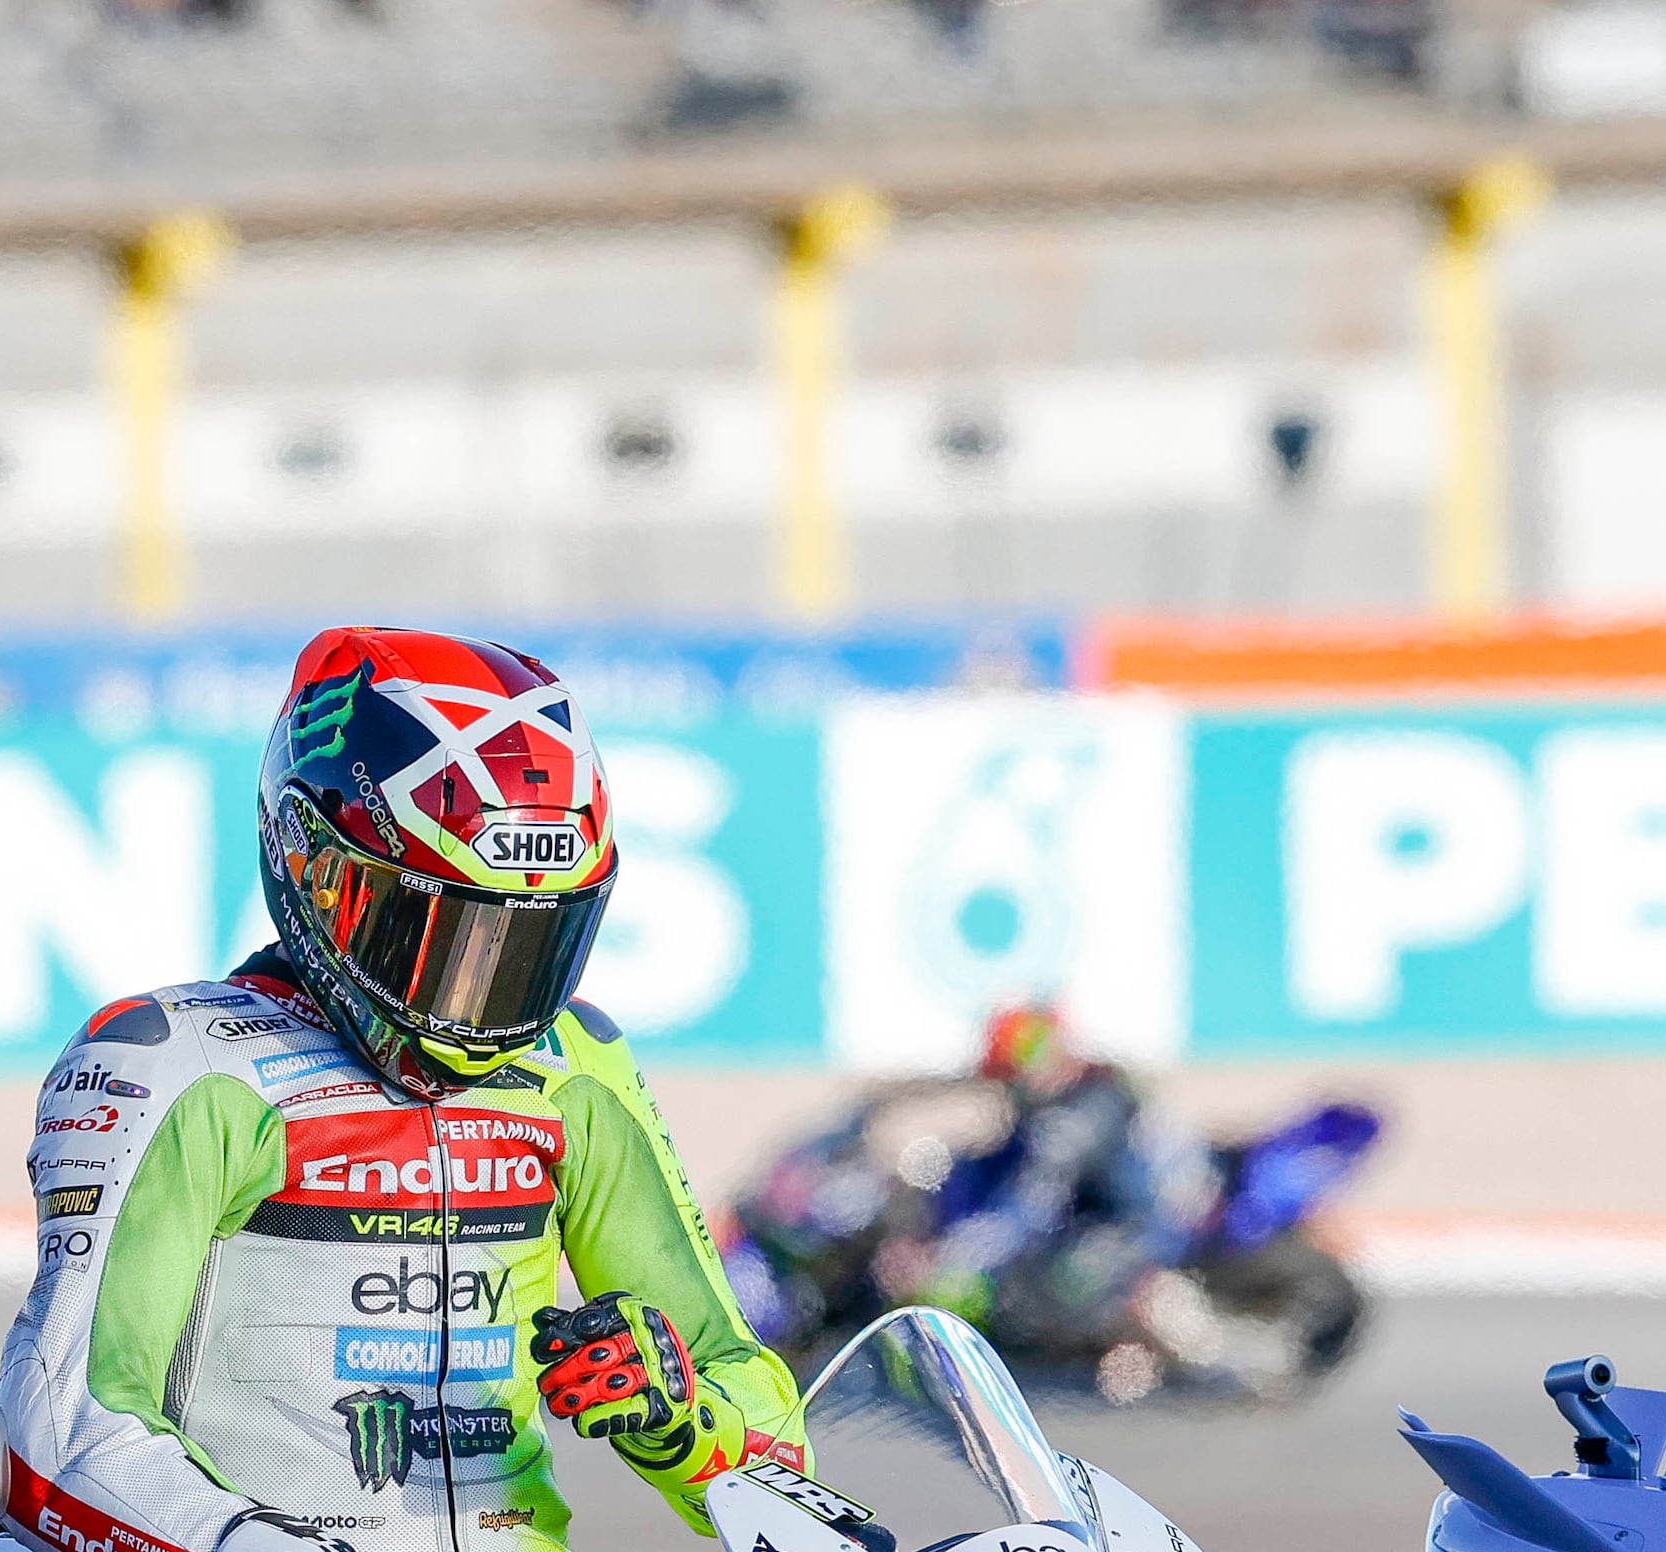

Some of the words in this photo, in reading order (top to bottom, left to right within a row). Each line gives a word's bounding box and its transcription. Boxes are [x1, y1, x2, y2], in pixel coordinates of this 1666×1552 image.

[492, 832, 576, 863] SHOEI
[403, 874, 441, 894] FASSI
[504, 898, 559, 911] Enduro
[341, 953, 409, 1013] RefrigiWear
[220, 1015, 293, 1040] SHOEI
[450, 1019, 539, 1040] CUPRA
[279, 1084, 378, 1108] BARRACUDA
[437, 1119, 559, 1157] PERTAMINA
[300, 1150, 545, 1195] Enduro
[461, 1221, 501, 1237] RACING
[502, 1222, 527, 1236] TEAM
[351, 1256, 515, 1324] ebay
